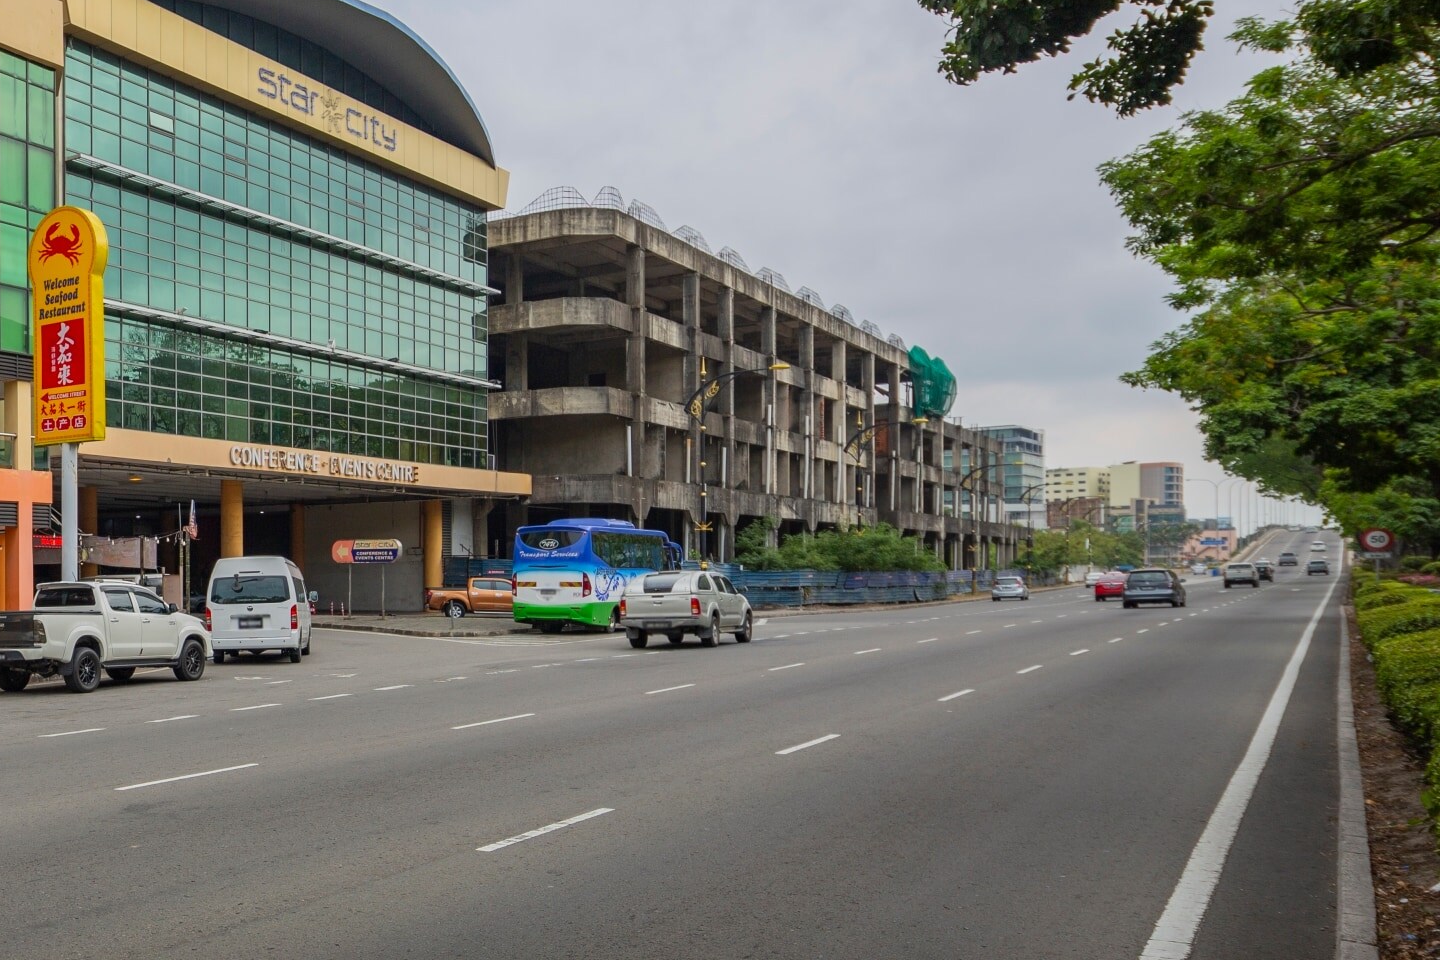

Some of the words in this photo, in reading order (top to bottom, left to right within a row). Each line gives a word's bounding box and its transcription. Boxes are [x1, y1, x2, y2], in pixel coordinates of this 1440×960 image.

[44, 275, 80, 291] Welcome
[45, 288, 78, 305] Seafood
[39, 301, 85, 320] Restaurant
[48, 392, 70, 400] WELCOME
[230, 445, 321, 473] CONFERENCE
[376, 463, 419, 483] CENTRE
[1370, 535, 1386, 544] 50
[519, 550, 550, 558] Transport
[551, 550, 578, 558] Services
